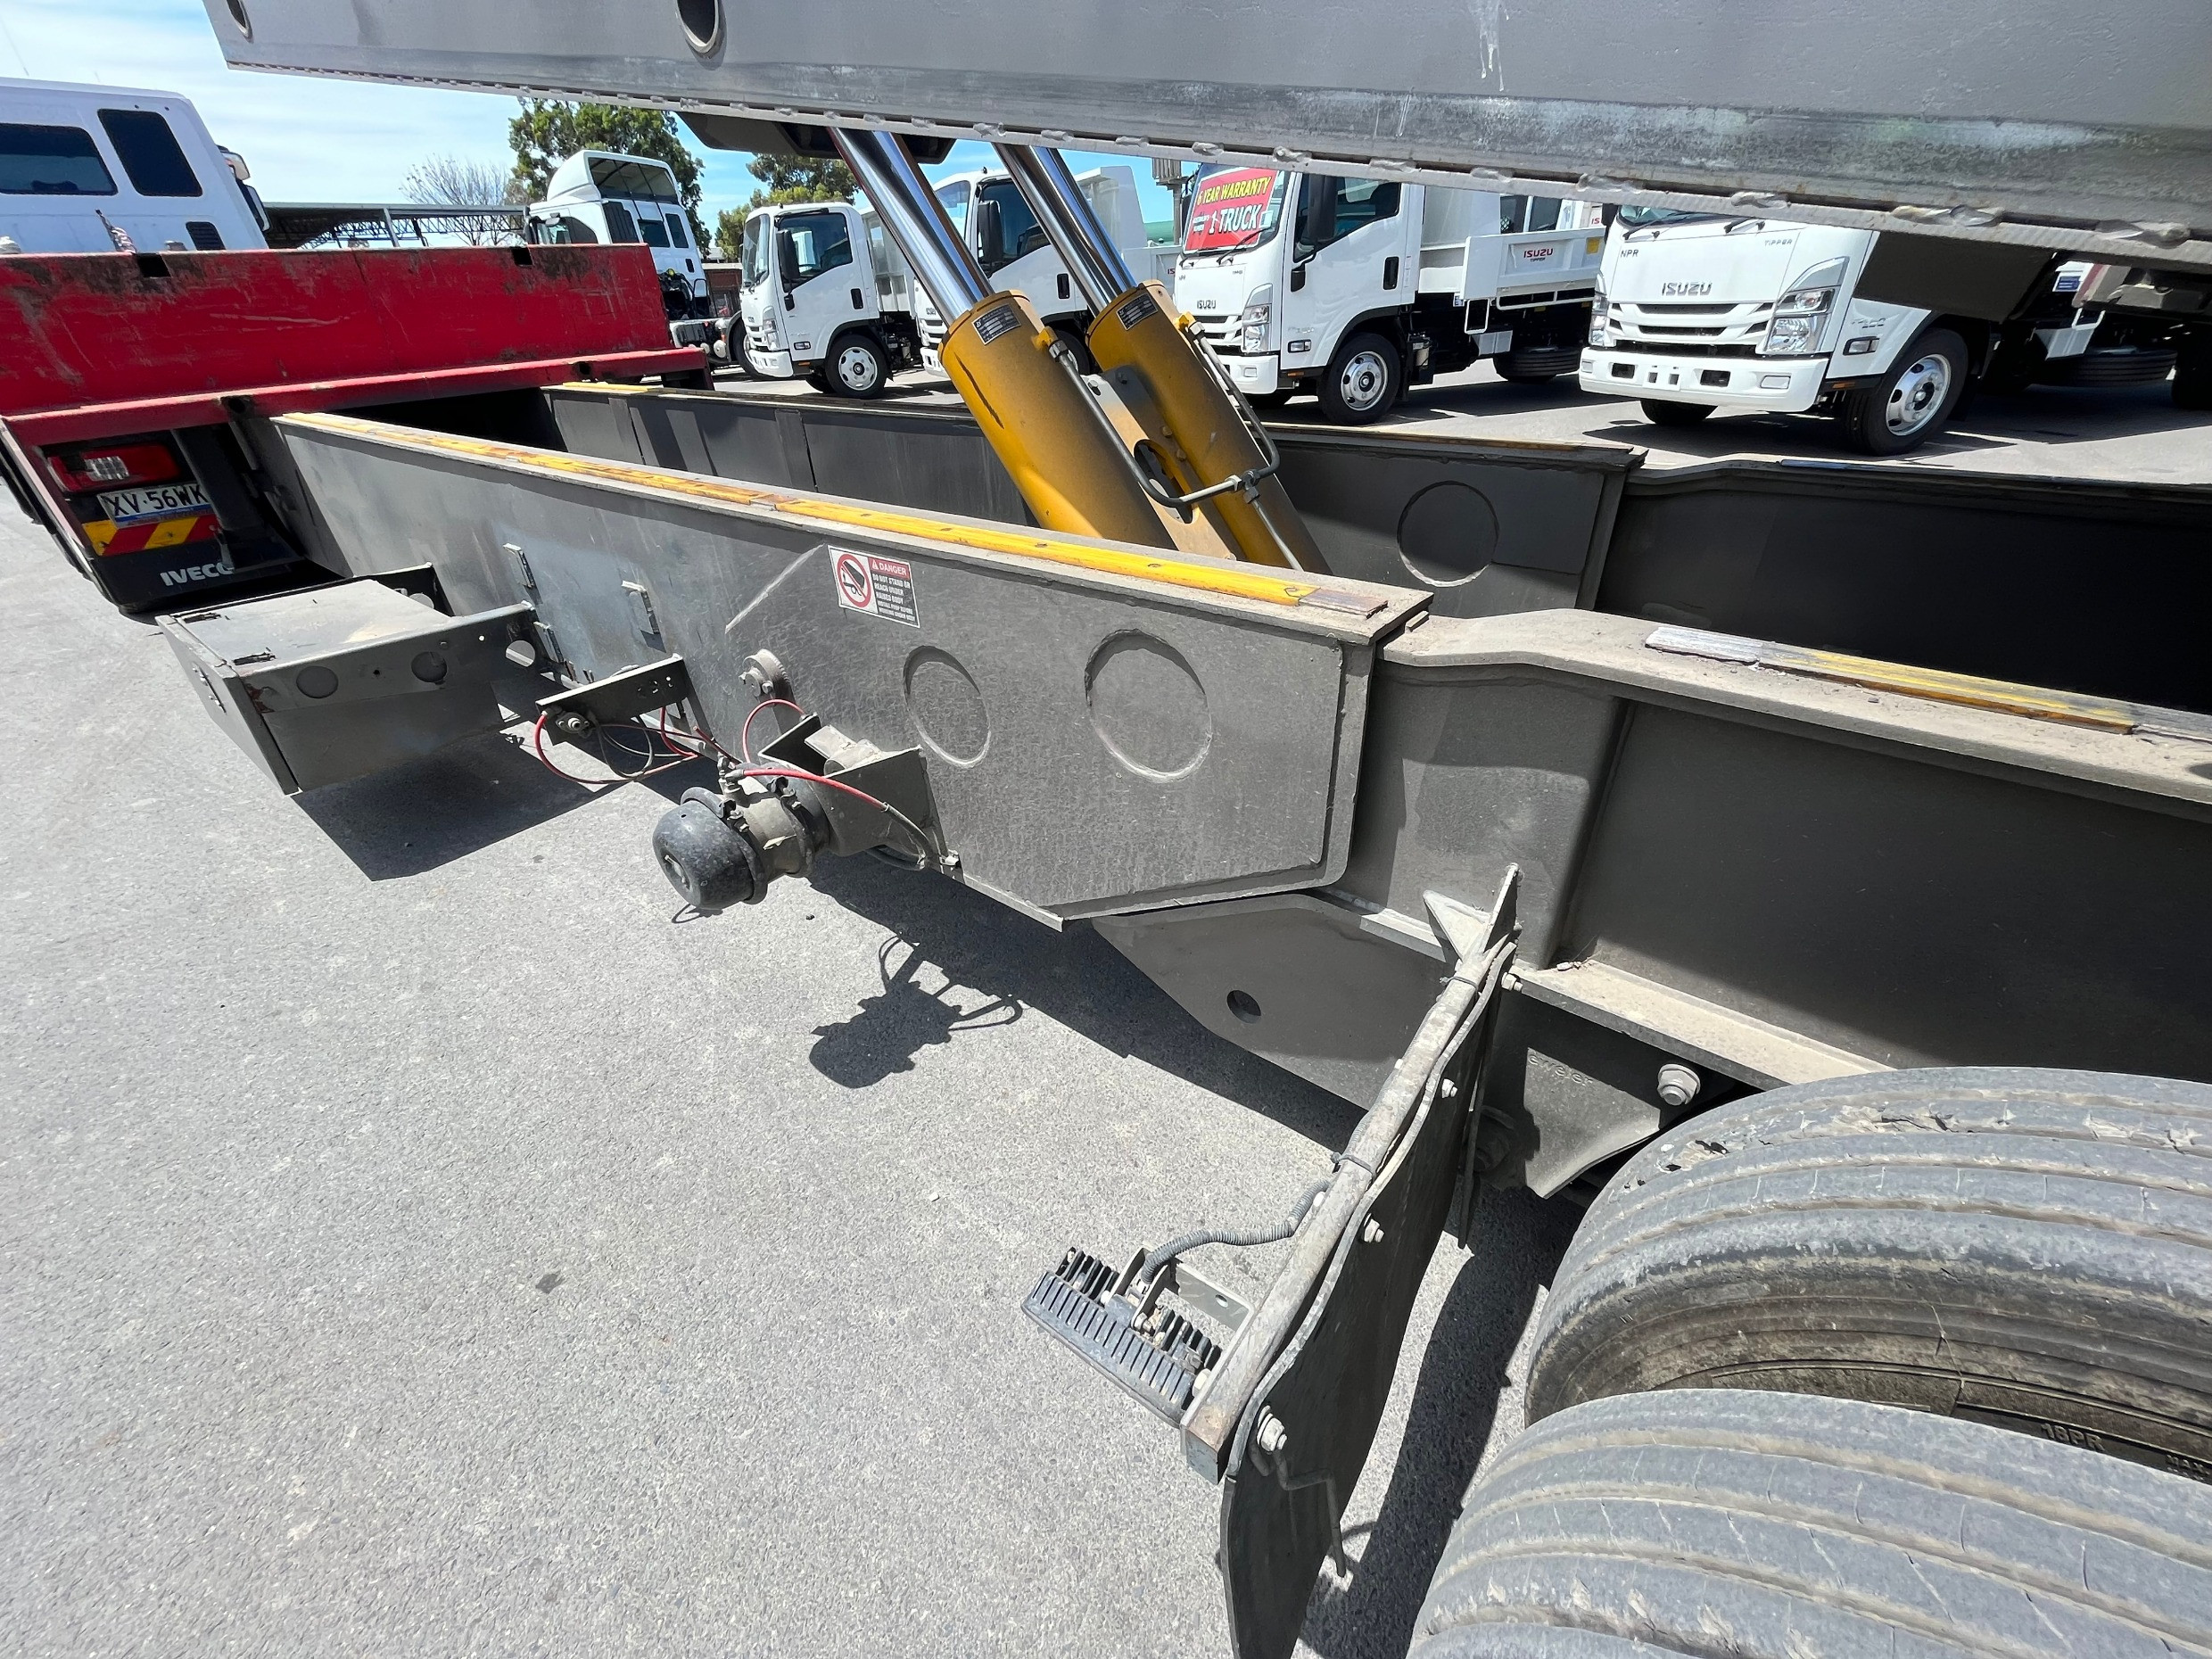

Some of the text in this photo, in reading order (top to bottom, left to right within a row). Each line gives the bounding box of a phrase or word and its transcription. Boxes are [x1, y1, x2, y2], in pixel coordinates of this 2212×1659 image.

[1197, 177, 1272, 205] 6 YEAR WARRANTY
[1218, 204, 1263, 233] TRUCK
[1523, 248, 1554, 258] ISUZU
[1621, 249, 1638, 258] NPR
[1662, 282, 1713, 296] ISUZU
[1197, 300, 1217, 310] ISUZU
[879, 562, 907, 575] DANGER
[888, 578, 904, 587] STAND
[2041, 1423, 2105, 1451] 18PR
